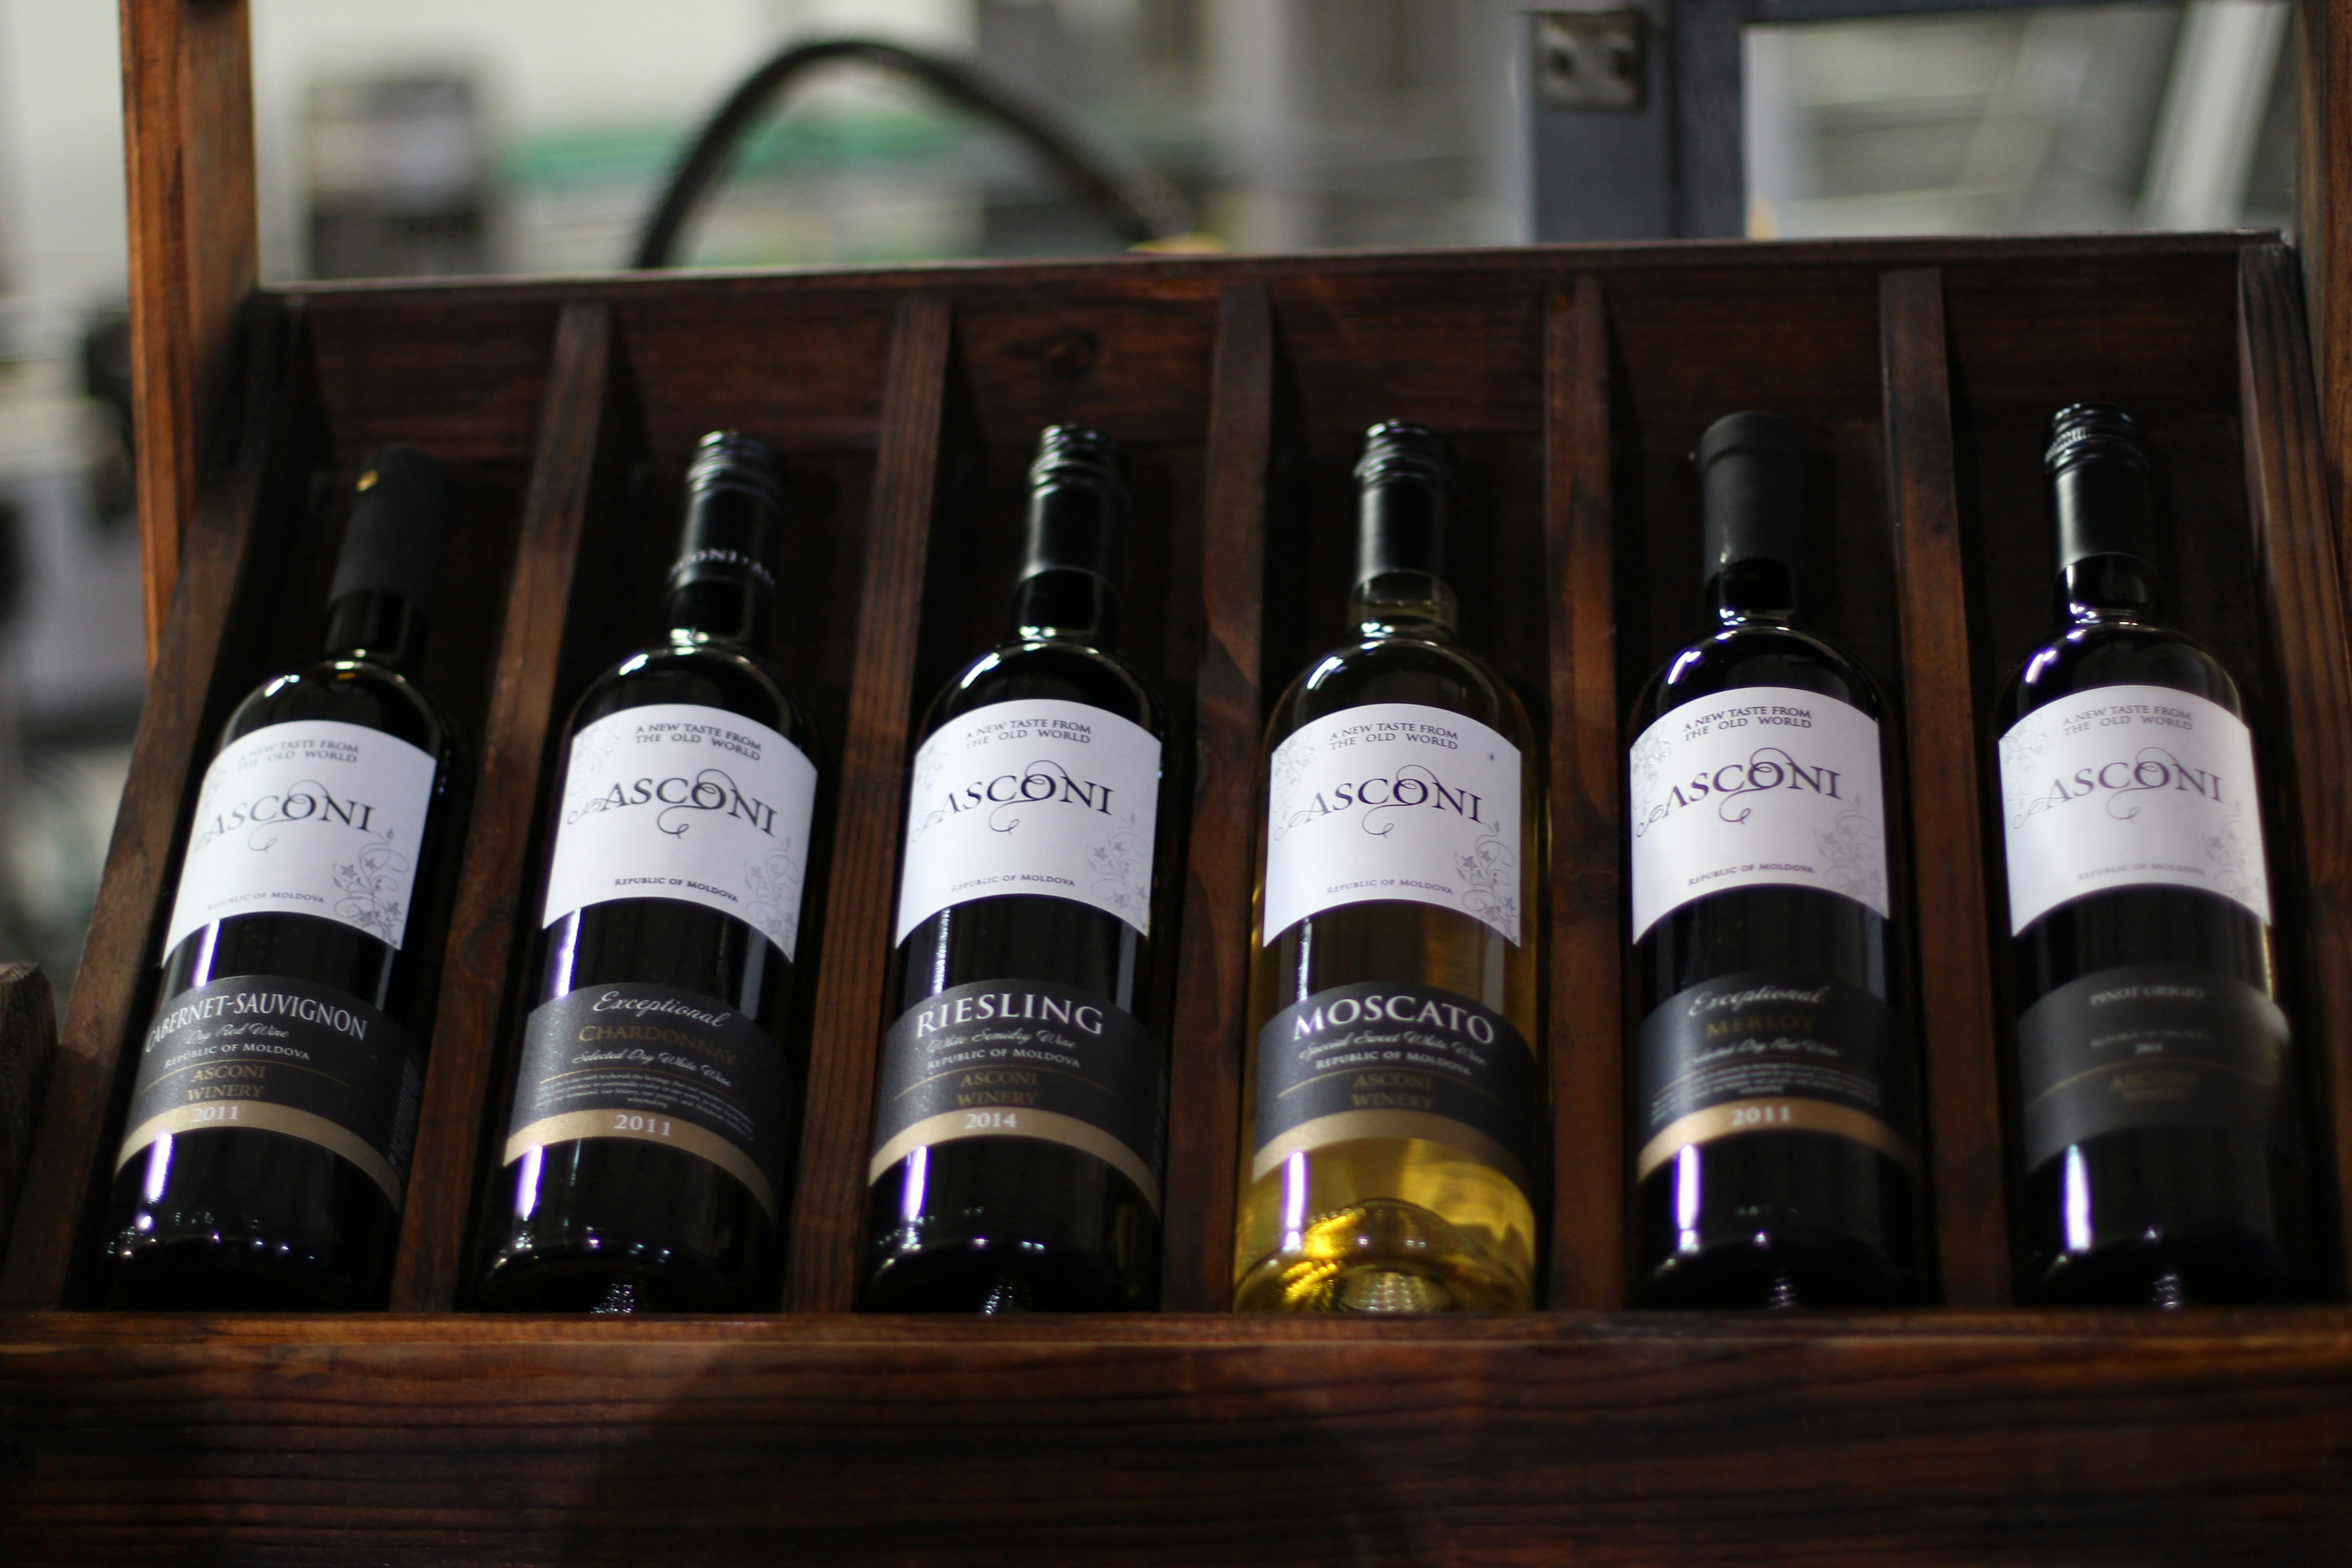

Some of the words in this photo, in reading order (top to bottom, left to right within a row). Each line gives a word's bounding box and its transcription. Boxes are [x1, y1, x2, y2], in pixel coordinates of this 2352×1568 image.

[1683, 722, 1691, 732] A
[1695, 711, 1726, 728] NEW
[1728, 706, 1768, 717] TASTE
[1771, 706, 1812, 719] FROM
[2063, 717, 2071, 726] A
[2074, 707, 2106, 721] NEW
[2110, 705, 2151, 715] TASTE
[2154, 705, 2192, 719] FROM
[2063, 721, 2091, 736] THE
[2099, 715, 2131, 727] OLD
[2140, 715, 2194, 730] WORLD
[635, 725, 644, 734] A
[648, 723, 680, 733] NEW
[683, 723, 722, 737] TASTE
[725, 731, 763, 752] FROM
[965, 731, 972, 740] A
[976, 722, 1006, 736] NEW
[1010, 719, 1048, 729] TASTE
[1052, 719, 1091, 734] FROM
[965, 735, 989, 749] THE
[998, 729, 1028, 741] OLD
[1037, 729, 1091, 744] WORLD
[1330, 731, 1338, 741] A
[1342, 724, 1372, 737] NEW
[1377, 722, 1416, 732] TASTE
[1419, 724, 1458, 741] FROM
[1684, 726, 1709, 741] THE
[1718, 717, 1748, 730] OLD
[1758, 716, 1812, 729] WORLD
[279, 739, 316, 750] TASTE
[319, 740, 359, 754] FROM
[635, 733, 662, 744] THE
[671, 733, 702, 744] OLD
[710, 737, 761, 762] WORLD
[1330, 737, 1356, 750] THE
[1365, 732, 1395, 742] OLD
[1406, 733, 1458, 750] WORLD
[267, 750, 296, 762] OLD
[305, 749, 357, 763] WORLD
[934, 771, 1114, 822] ASCONI
[1659, 760, 1842, 819] ASCONI
[2042, 759, 2222, 811] ASCONI
[593, 773, 779, 838] ASCONI
[1299, 774, 1483, 824] ASCONI
[204, 790, 376, 842] ASCONI
[951, 875, 999, 892] REPUBLIC
[1002, 874, 1018, 882] OF
[1020, 873, 1076, 887] MOLDOVA
[1687, 866, 1736, 886] REPUBLIC
[1740, 863, 1754, 872] OF
[1759, 863, 1815, 874] MOLDOVA
[270, 891, 325, 903] MOLDOVA
[614, 876, 666, 887] REPUBLIC
[668, 877, 683, 886] OF
[687, 879, 739, 903] MOLDOVA
[1326, 878, 1377, 894] REPUBLIC
[1399, 878, 1454, 895] MOLDOVA
[593, 990, 731, 1027] Exceptional
[1688, 985, 1831, 1017] Exceptional
[145, 992, 367, 1053] CABERNET-SAUVIGNON
[916, 993, 1103, 1038] RIESLING
[1294, 995, 1494, 1045] MOSCATO
[216, 1022, 249, 1037] Red
[249, 1022, 291, 1038] Wine
[164, 1045, 218, 1069] REPUBLIC
[221, 1043, 239, 1053] OF
[243, 1042, 310, 1060] MOLDOVA
[578, 1025, 737, 1066] CHARDONNAY
[628, 1048, 655, 1065] Dry
[658, 1052, 697, 1071] White
[926, 1049, 986, 1070] REPUBLIC
[989, 1048, 1008, 1057] OF
[1013, 1048, 1080, 1068] MOLDOVA
[1315, 1051, 1380, 1070] REPUBLIC
[1382, 1051, 1402, 1060] OF
[1406, 1051, 1471, 1076] MOLDOVA
[191, 1065, 267, 1083] ASCONI
[959, 1070, 1038, 1087] ASCONI
[1354, 1073, 1432, 1089] ASCONI
[187, 1084, 266, 1101] WINERY
[956, 1090, 1038, 1105] WINERY
[192, 1104, 239, 1123] 2011
[964, 1112, 1018, 1130] 2014
[1732, 1106, 1792, 1127] 2011
[613, 1114, 671, 1137] 2011
